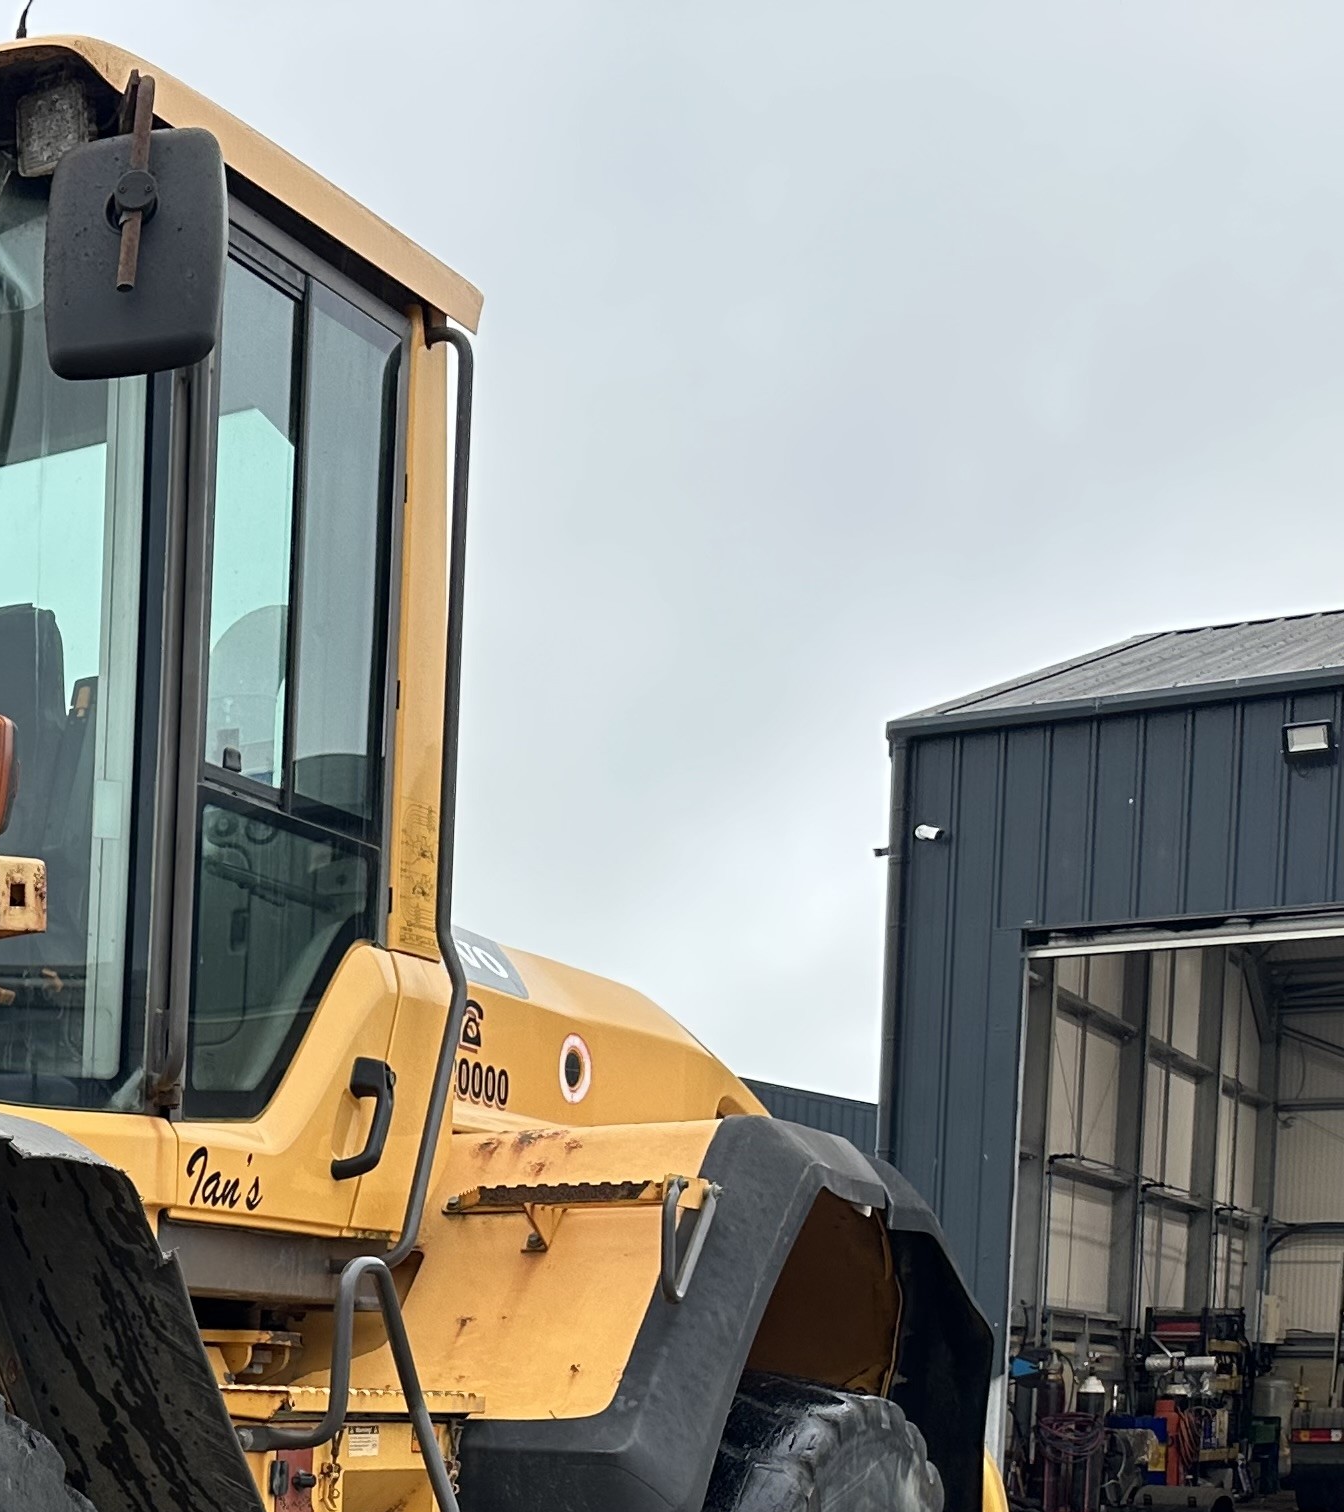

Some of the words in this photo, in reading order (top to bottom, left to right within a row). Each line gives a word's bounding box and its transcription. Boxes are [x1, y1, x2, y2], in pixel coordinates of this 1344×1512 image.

[454, 940, 509, 979] VO
[454, 1057, 509, 1111] 0000
[186, 1146, 263, 1211] Ian's
